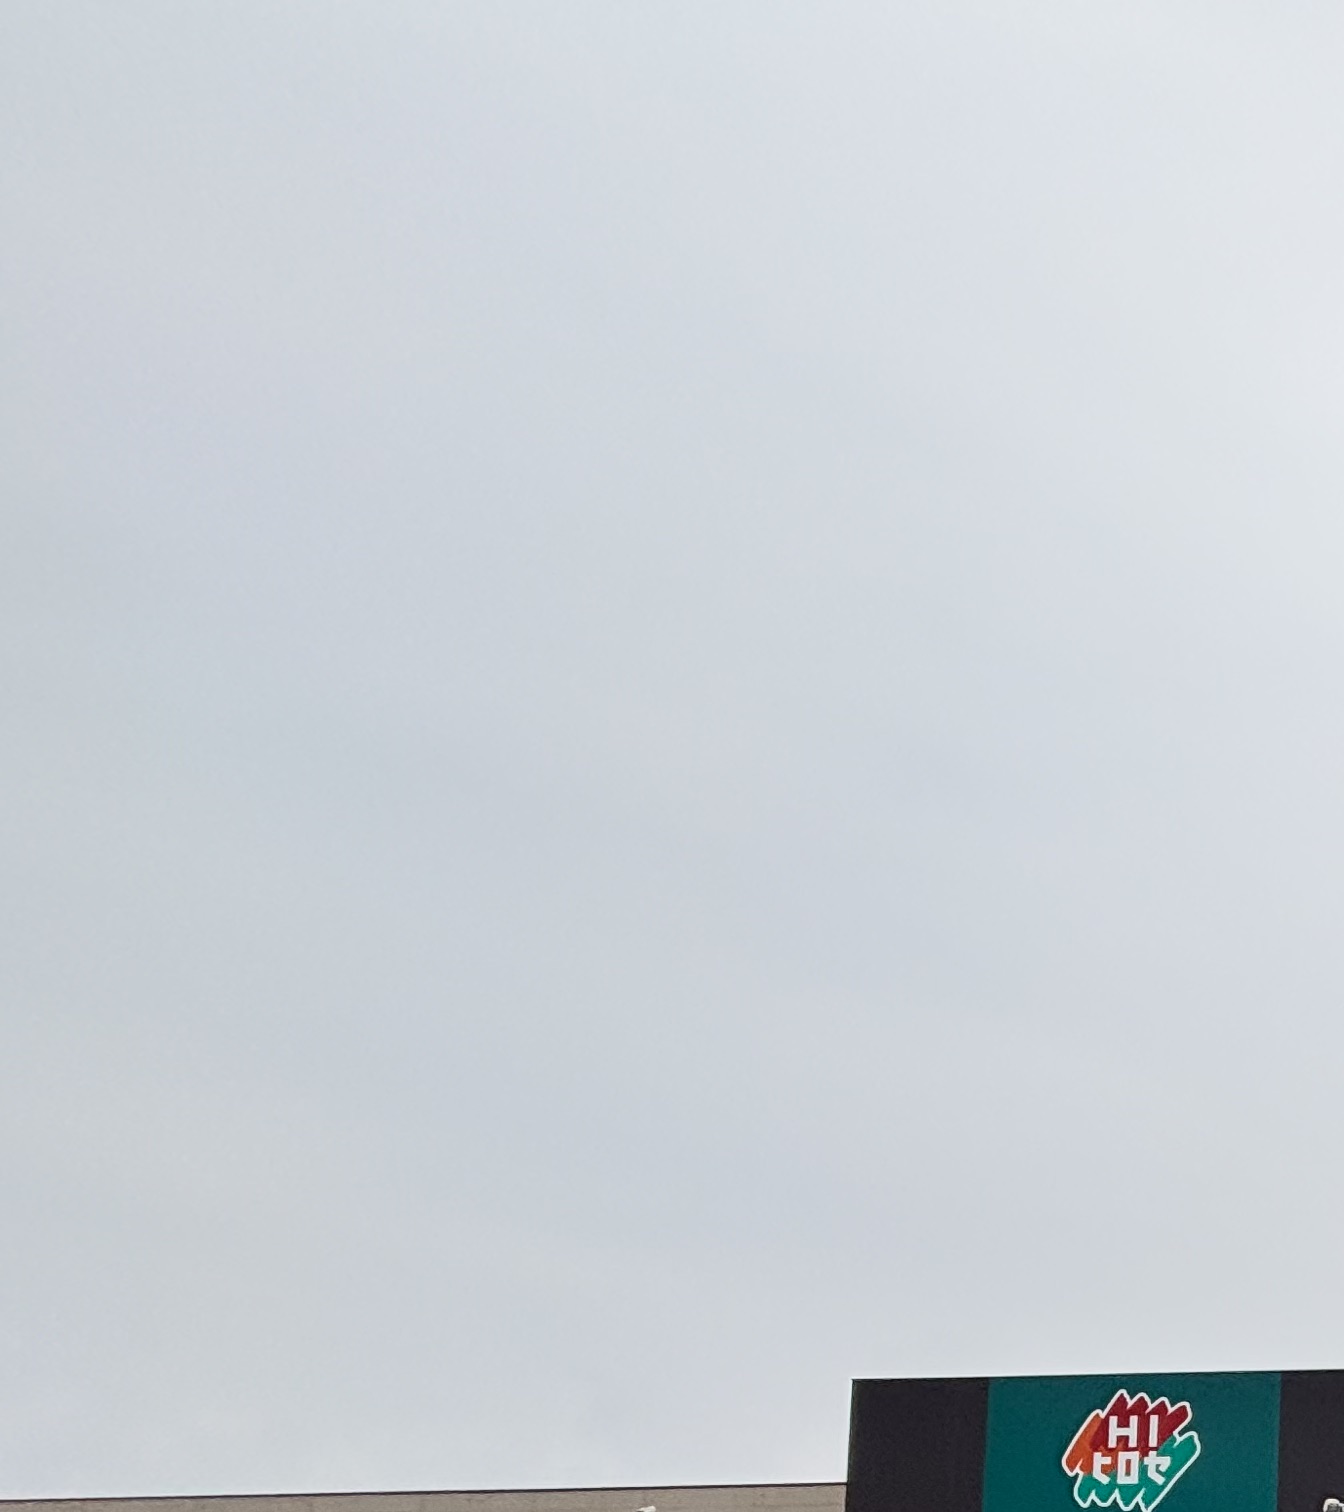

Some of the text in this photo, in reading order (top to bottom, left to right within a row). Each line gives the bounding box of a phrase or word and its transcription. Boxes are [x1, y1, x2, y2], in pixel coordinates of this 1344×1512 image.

[1108, 1414, 1159, 1448] HI
[1093, 1450, 1171, 1485] ヒロセ
